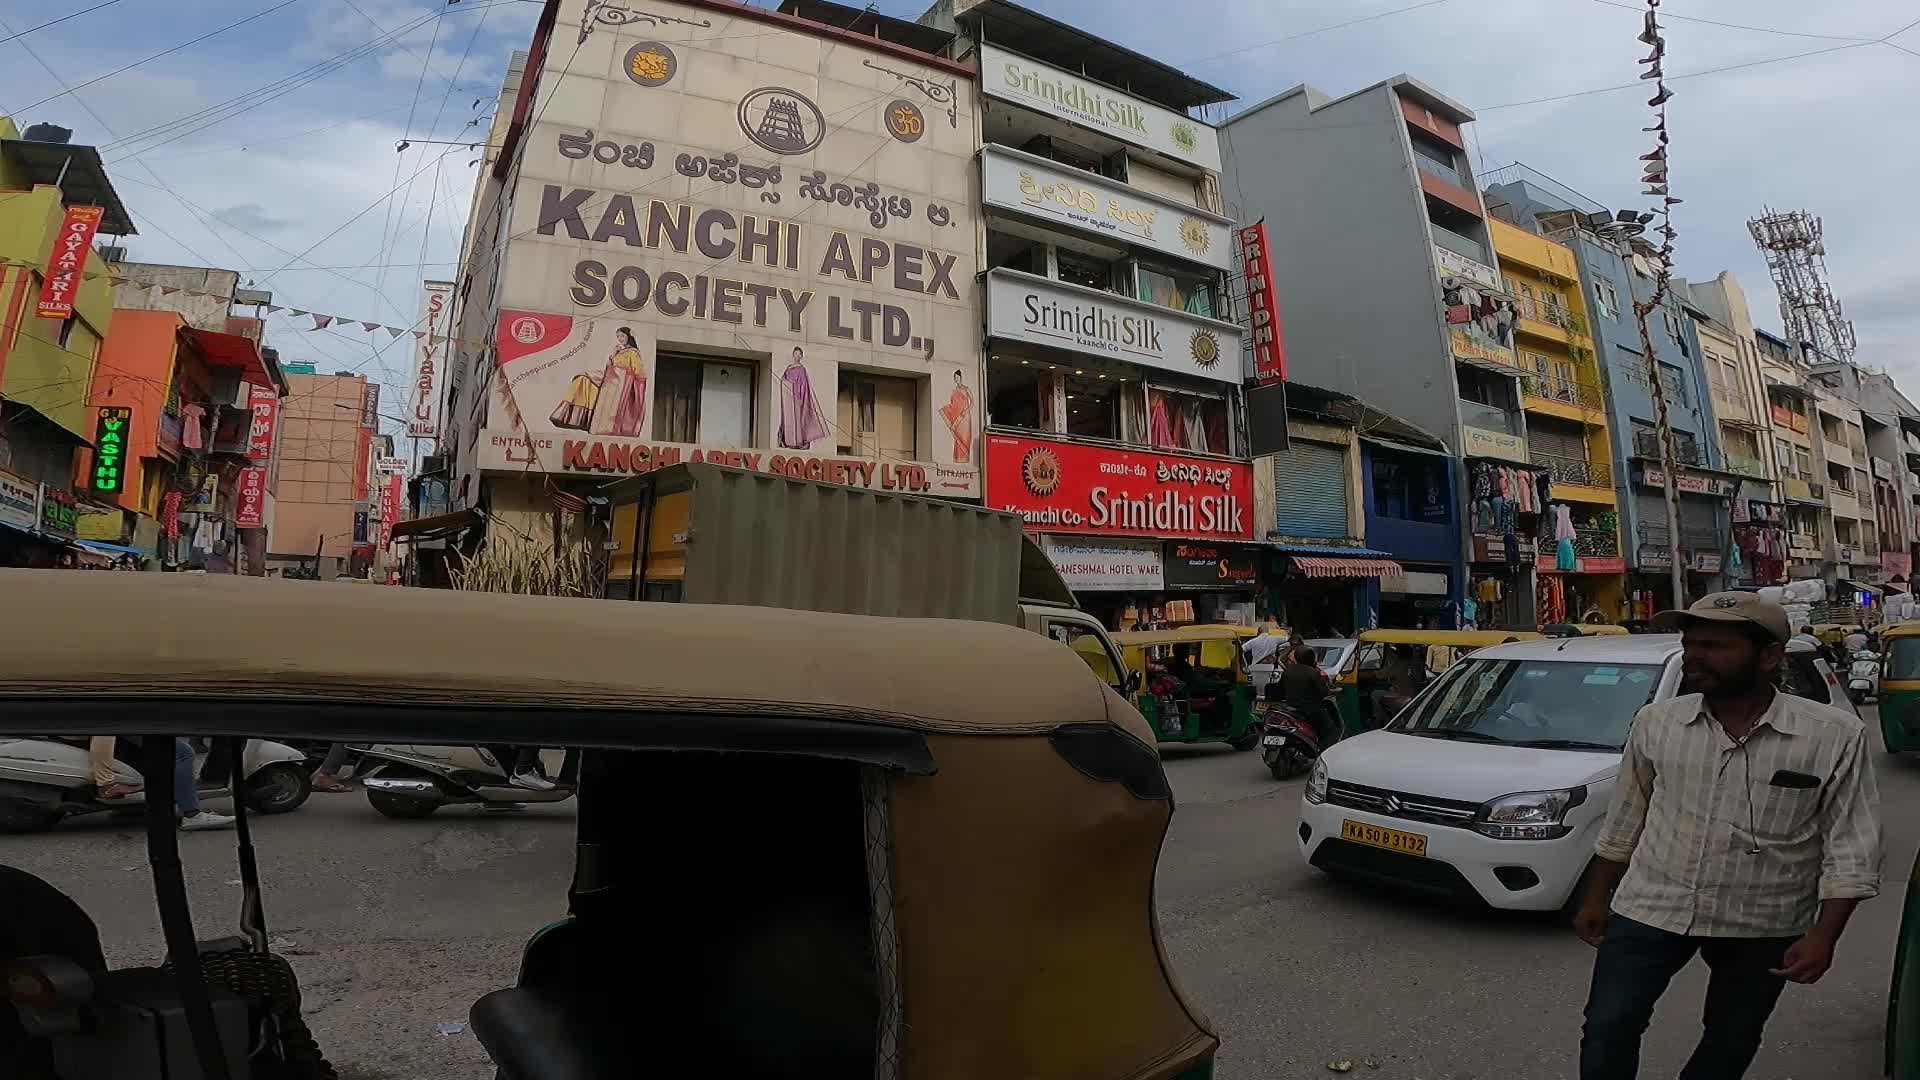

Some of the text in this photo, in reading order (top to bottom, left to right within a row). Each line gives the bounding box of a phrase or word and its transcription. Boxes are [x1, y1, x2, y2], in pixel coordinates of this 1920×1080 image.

[1004, 63, 1147, 134] Srinidhi Silk
[1053, 103, 1110, 127] International
[558, 129, 655, 170] ಕಂಚಿ
[675, 152, 783, 204] ಅಪೆಕ್ಸ್
[537, 184, 960, 300] KANCHI APEX
[39, 301, 72, 311] SILKS
[1242, 228, 1273, 363] SRINIDHI
[569, 260, 934, 361] SOCIETY LTD.,
[1024, 294, 1163, 352] Srinidhi Silk
[1076, 335, 1119, 352] Kaanchi Co
[508, 358, 559, 389] ancheepuram
[1257, 367, 1280, 380] SILK
[409, 423, 434, 434] Silks
[563, 439, 681, 472] KANCHI
[769, 454, 876, 488] SOCIETY
[882, 463, 931, 492] LTD.
[936, 468, 974, 479] ENTRANCE
[1157, 460, 1201, 486] ಶ್ರೀನಿಧಿ
[1090, 487, 1194, 532] Srinidhi
[1199, 495, 1244, 533] Silk
[1110, 565, 1134, 575] HOTEL
[1138, 565, 1160, 575] WARE
[1349, 824, 1425, 851] KA 50 B 3132
